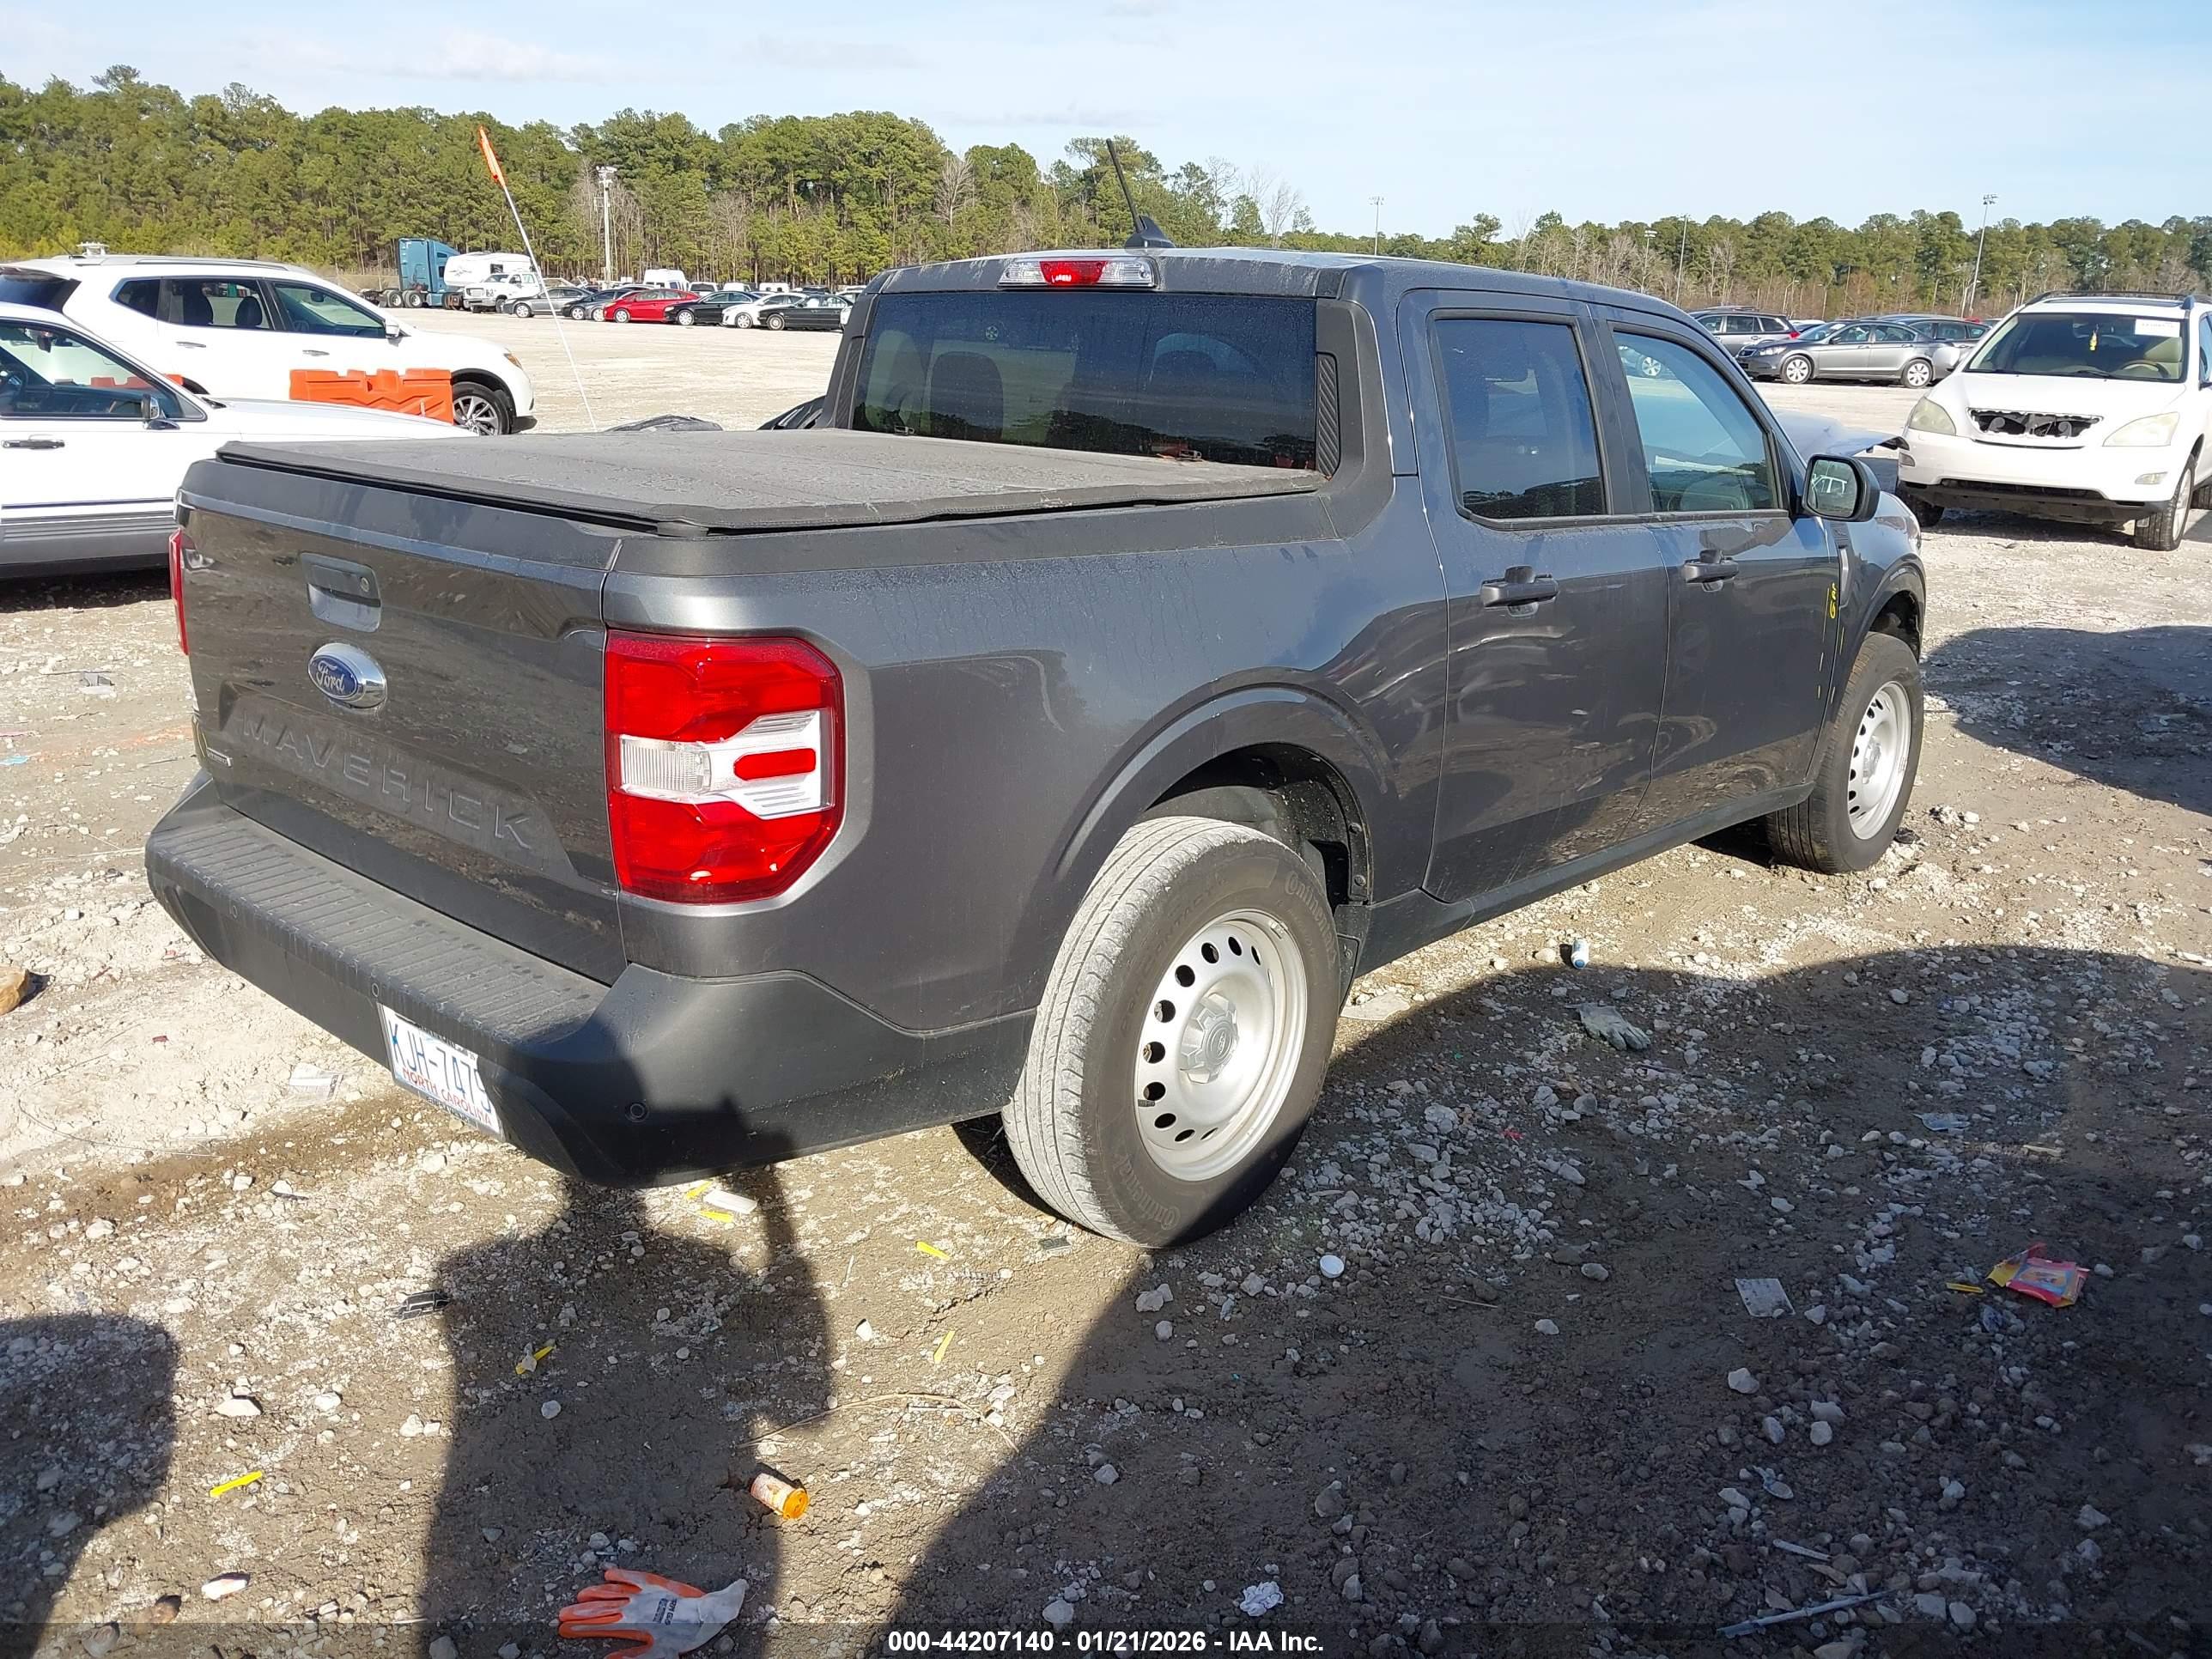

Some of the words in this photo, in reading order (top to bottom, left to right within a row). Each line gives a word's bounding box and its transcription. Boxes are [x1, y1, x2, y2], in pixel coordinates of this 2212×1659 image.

[315, 659, 345, 694] Ford
[242, 709, 532, 850] MAVERICK
[402, 1067, 439, 1096] NORTH
[441, 1088, 492, 1125] CAROLINA
